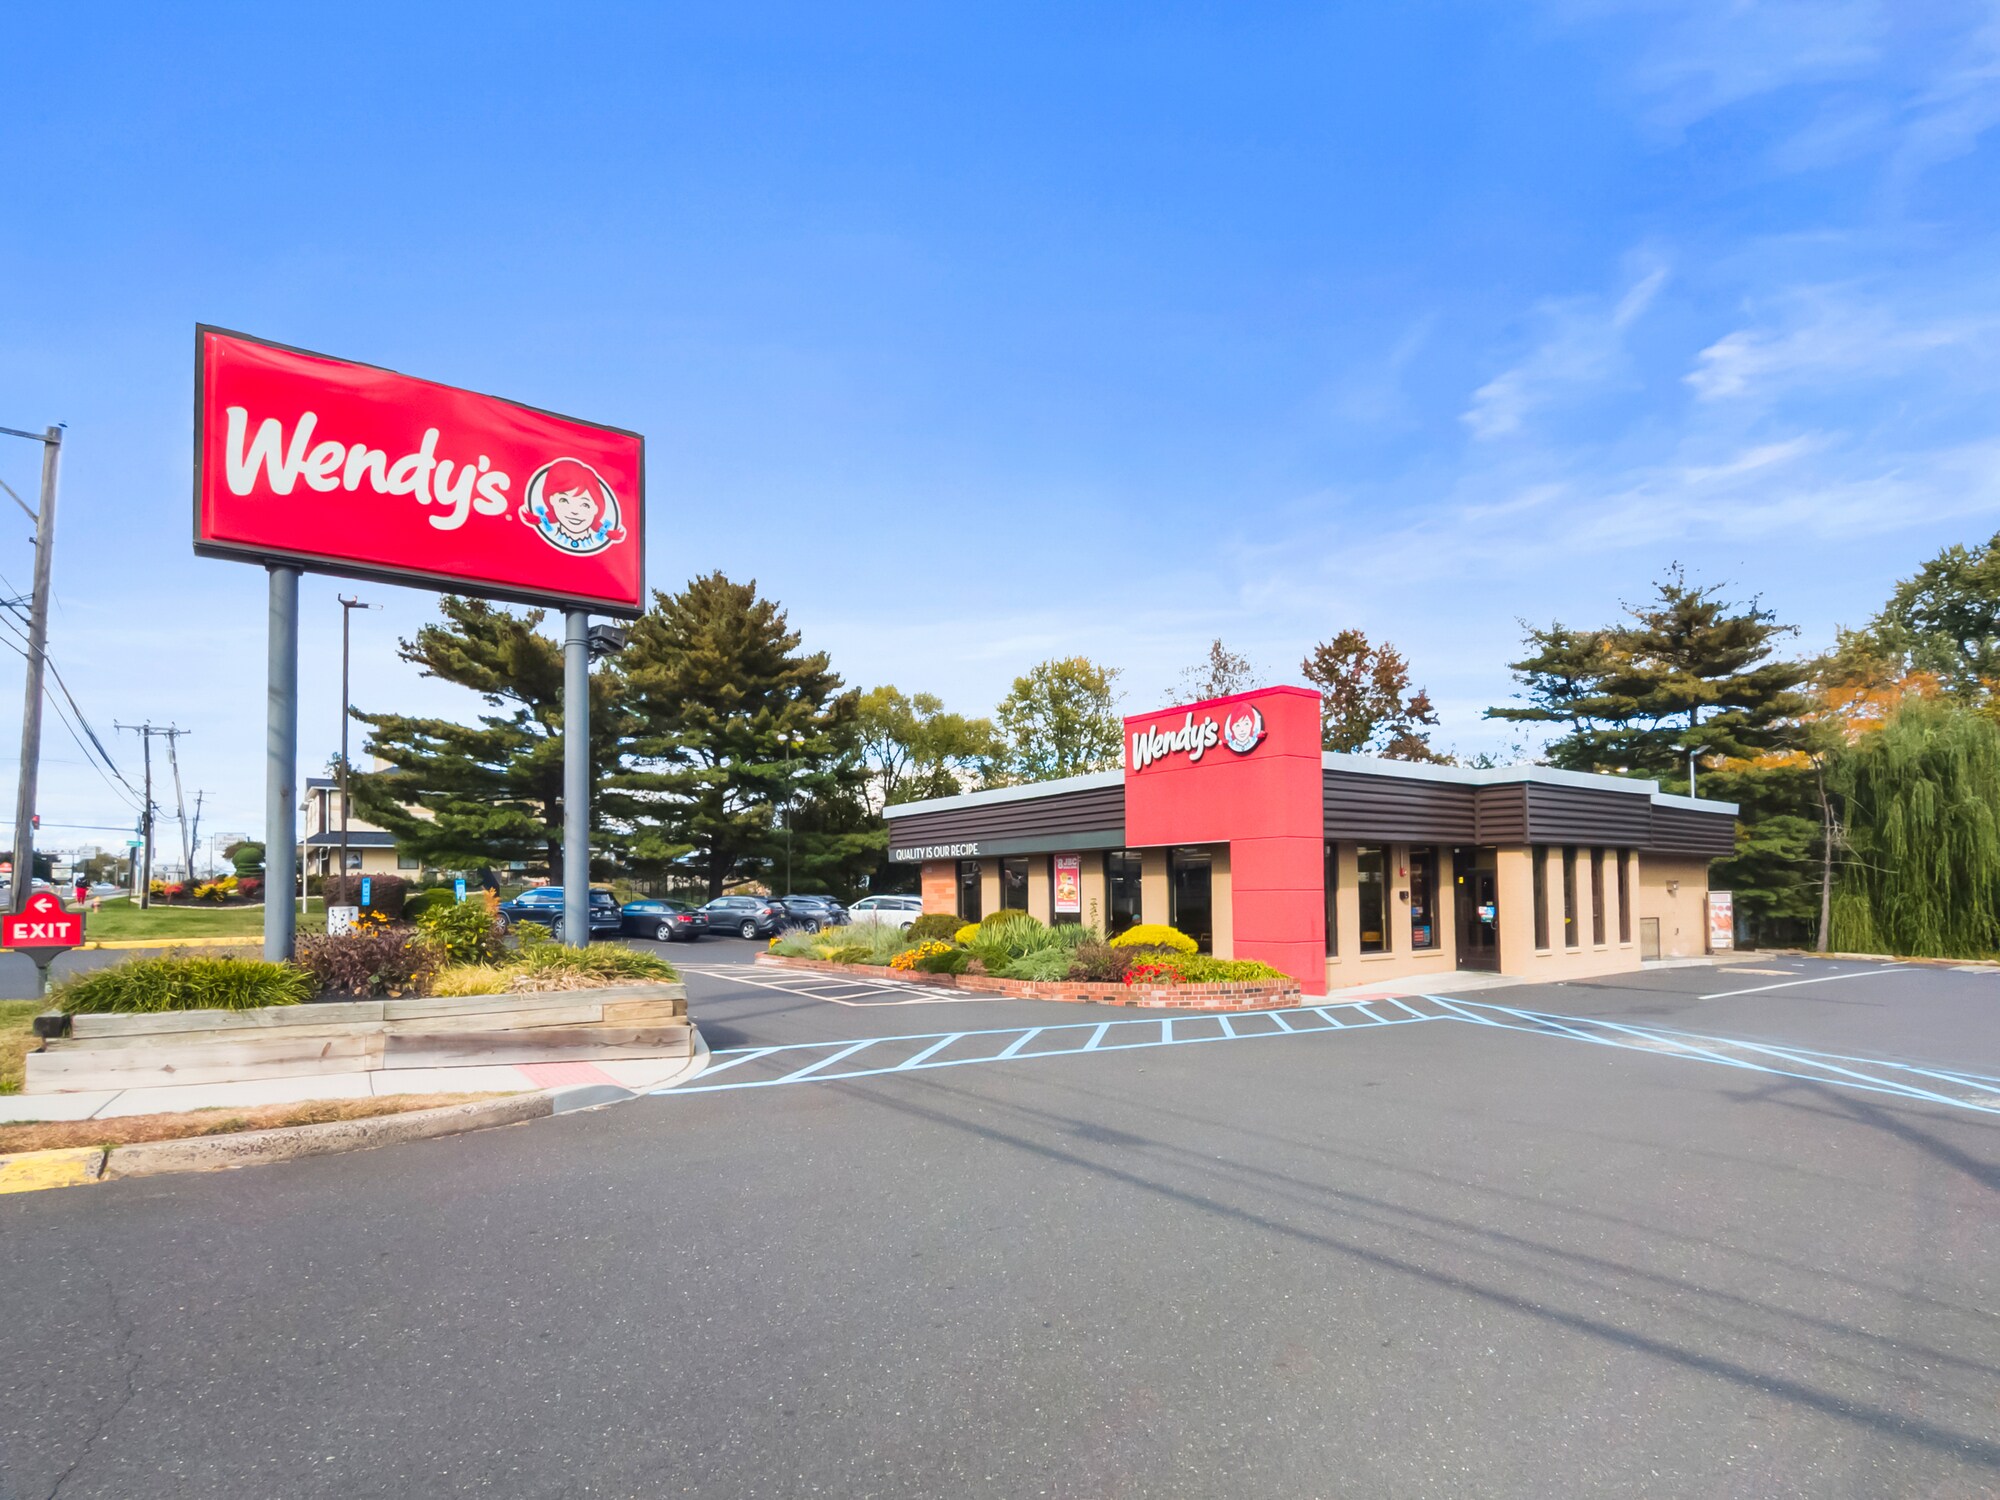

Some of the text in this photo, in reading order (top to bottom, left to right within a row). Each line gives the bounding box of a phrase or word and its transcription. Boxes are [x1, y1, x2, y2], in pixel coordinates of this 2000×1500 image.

[226, 406, 510, 530] Wendy's
[1132, 711, 1219, 771] Wendy's
[896, 847, 925, 861] QUALITY
[926, 846, 932, 858] IS
[934, 845, 950, 858] OUR
[13, 922, 72, 939] EXIT
